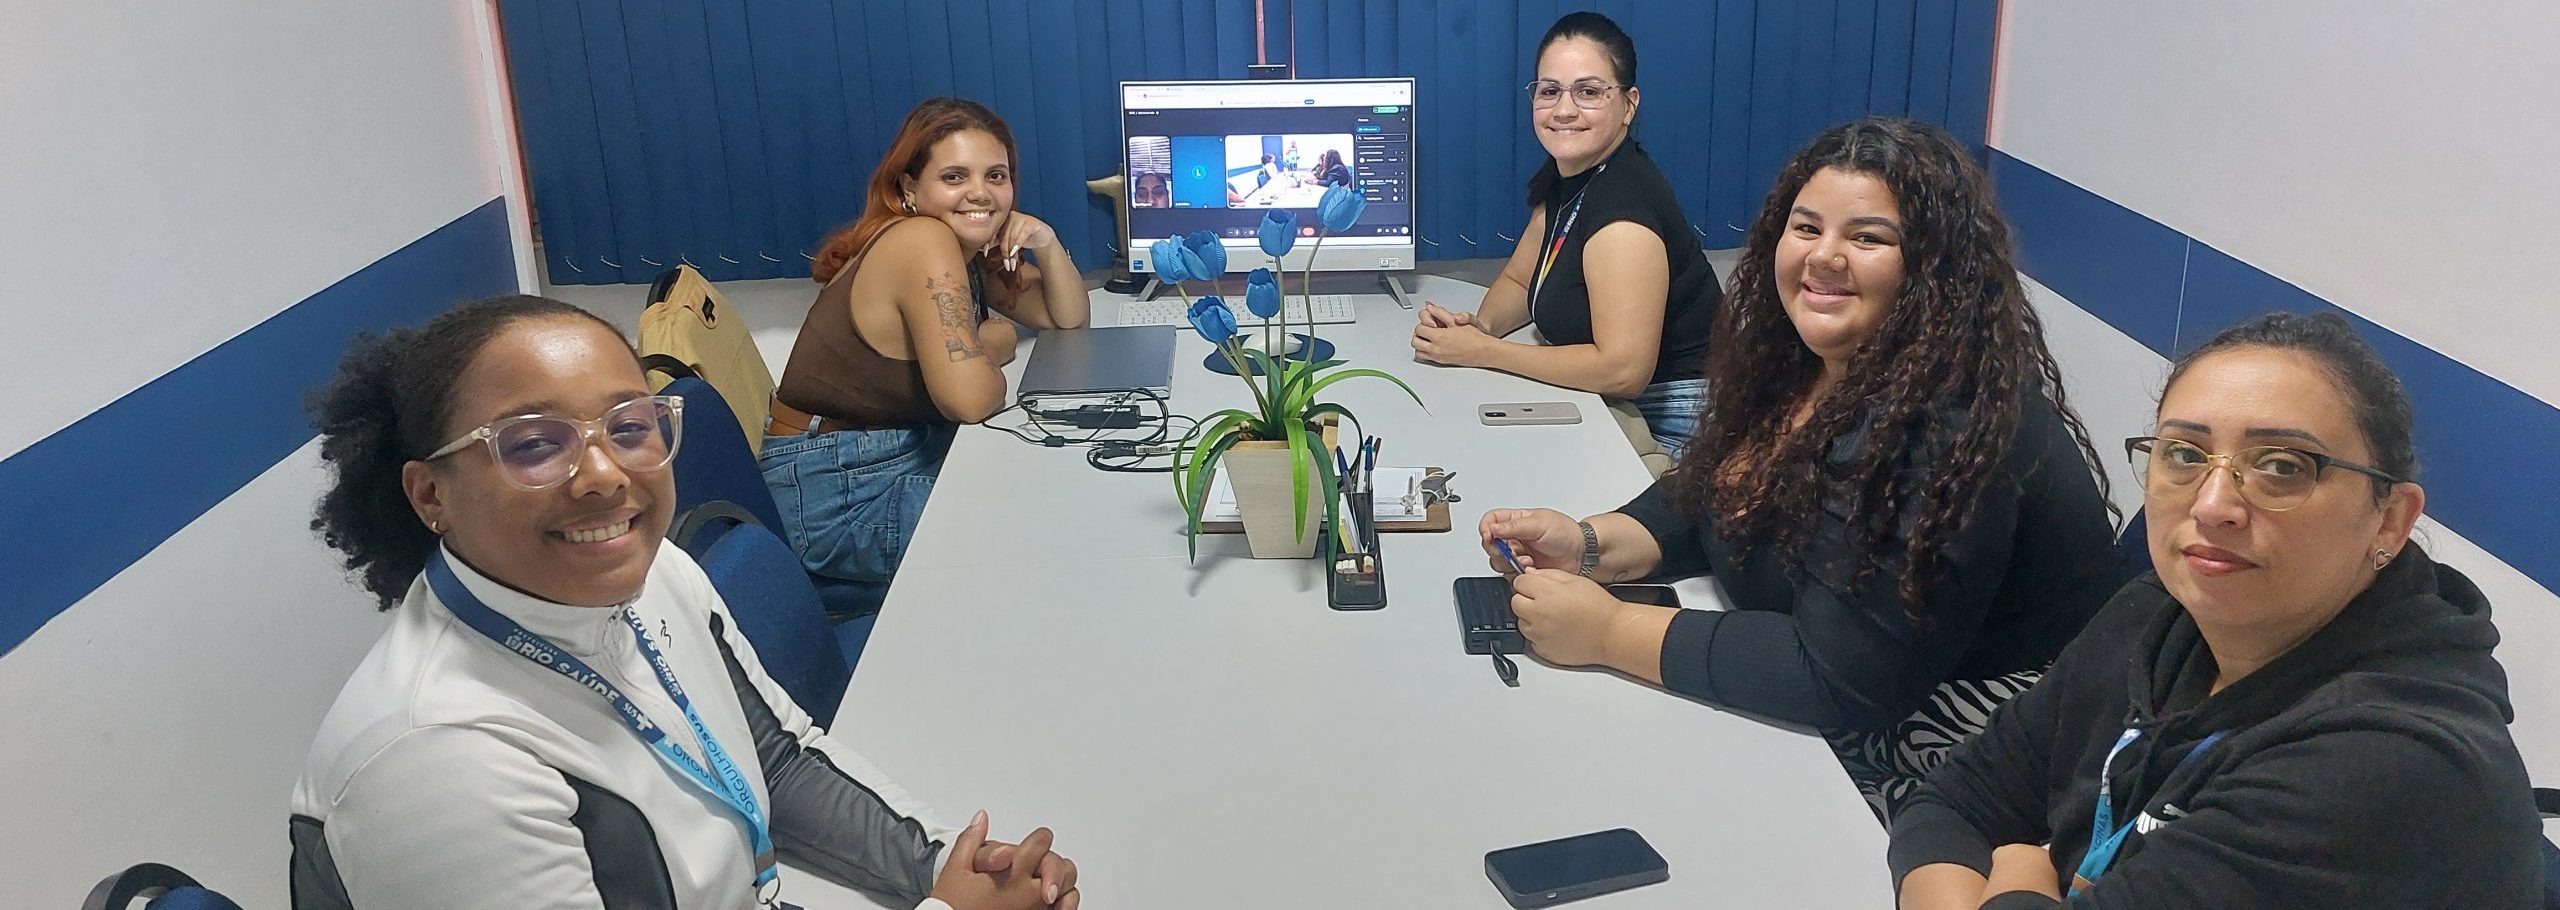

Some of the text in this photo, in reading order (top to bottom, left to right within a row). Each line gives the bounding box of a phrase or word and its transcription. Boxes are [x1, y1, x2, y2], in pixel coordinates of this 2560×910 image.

[520, 642, 620, 704] RIO SAÚDE
[627, 607, 676, 683] RIO SAÚD
[622, 702, 638, 719] SUS
